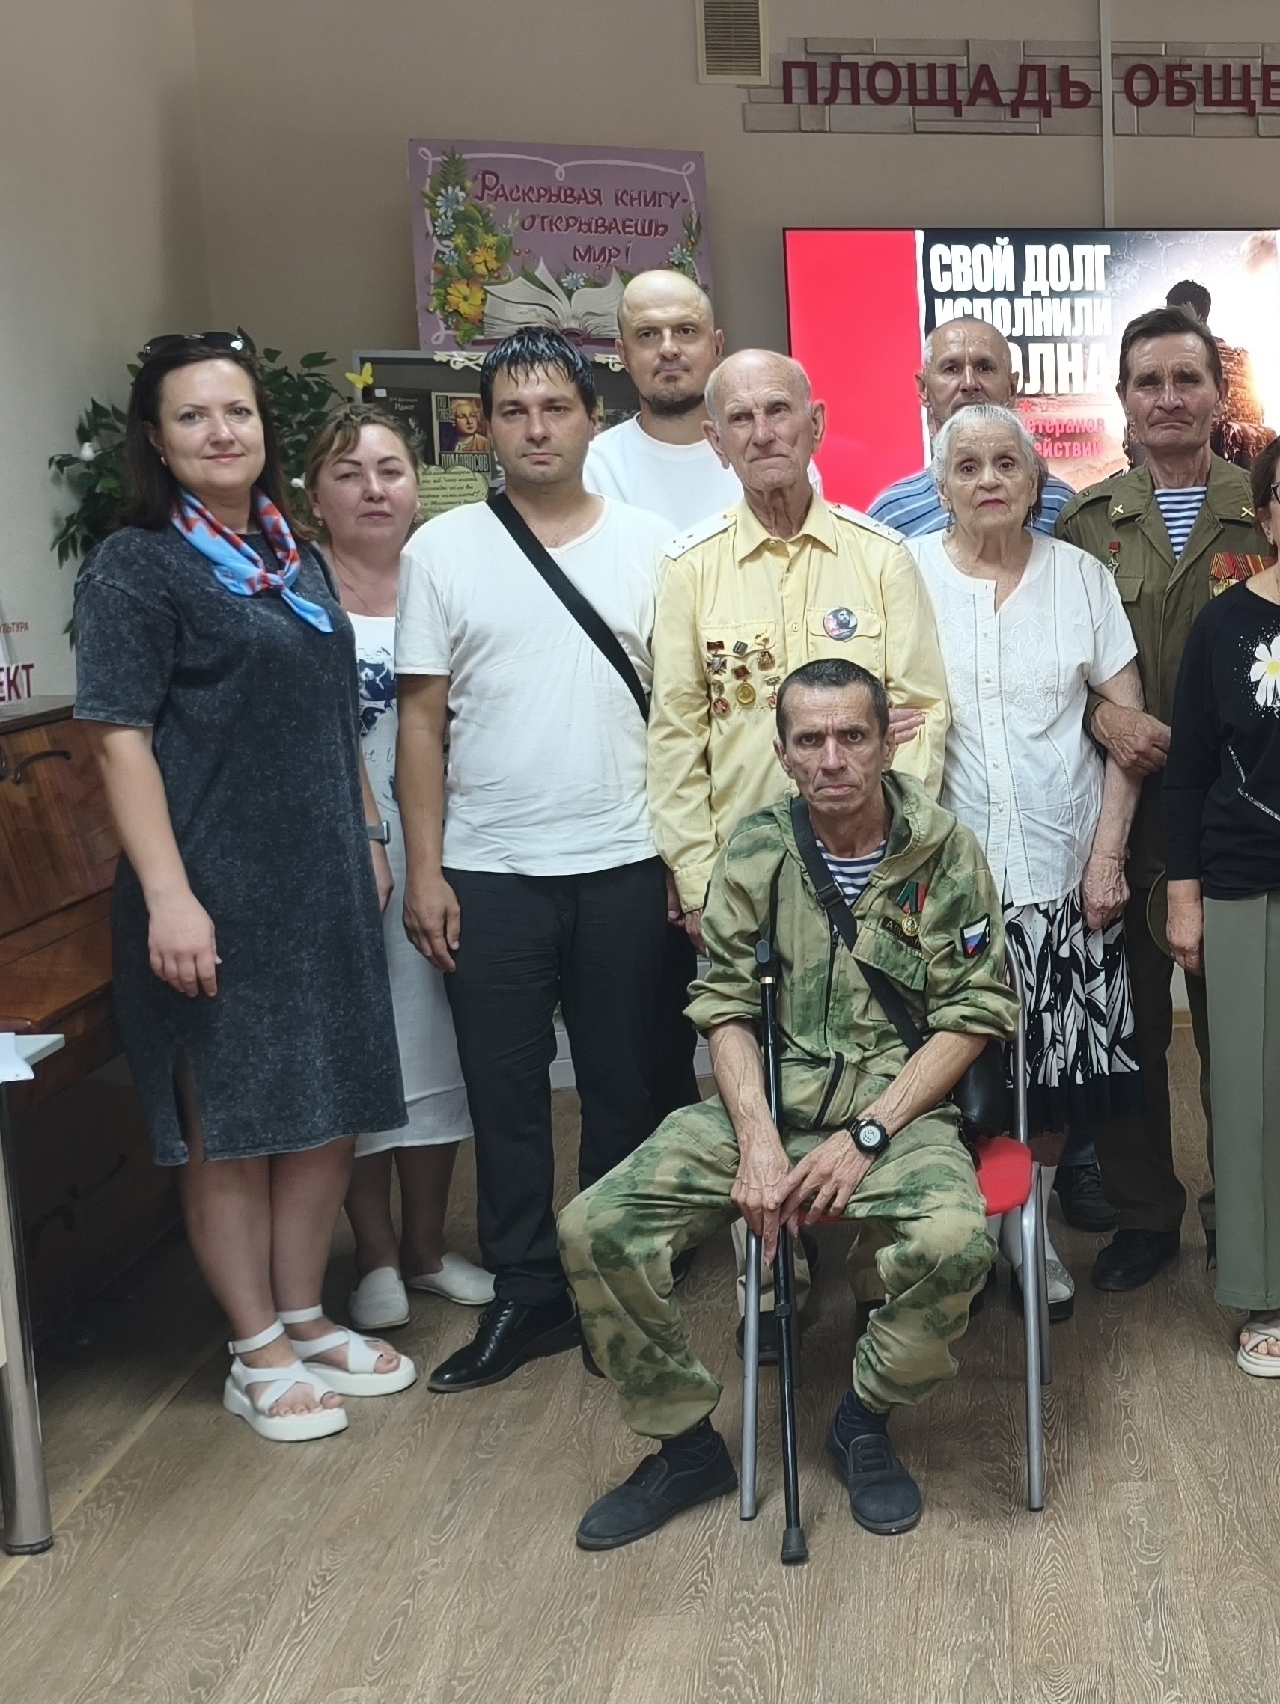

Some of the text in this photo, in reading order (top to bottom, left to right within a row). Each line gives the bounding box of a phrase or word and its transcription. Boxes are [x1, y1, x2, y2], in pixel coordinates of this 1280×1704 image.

[781, 60, 1093, 118] ПЛОЩАДЬ
[520, 213, 669, 238] ОТКРЫВАЕШЬ
[572, 241, 632, 265] МИР!
[929, 236, 1111, 297] СВОЙ ДОЛГ
[1007, 341, 1110, 394] ОЛНА
[1026, 418, 1105, 437] етеранов
[1033, 438, 1101, 458] ействий
